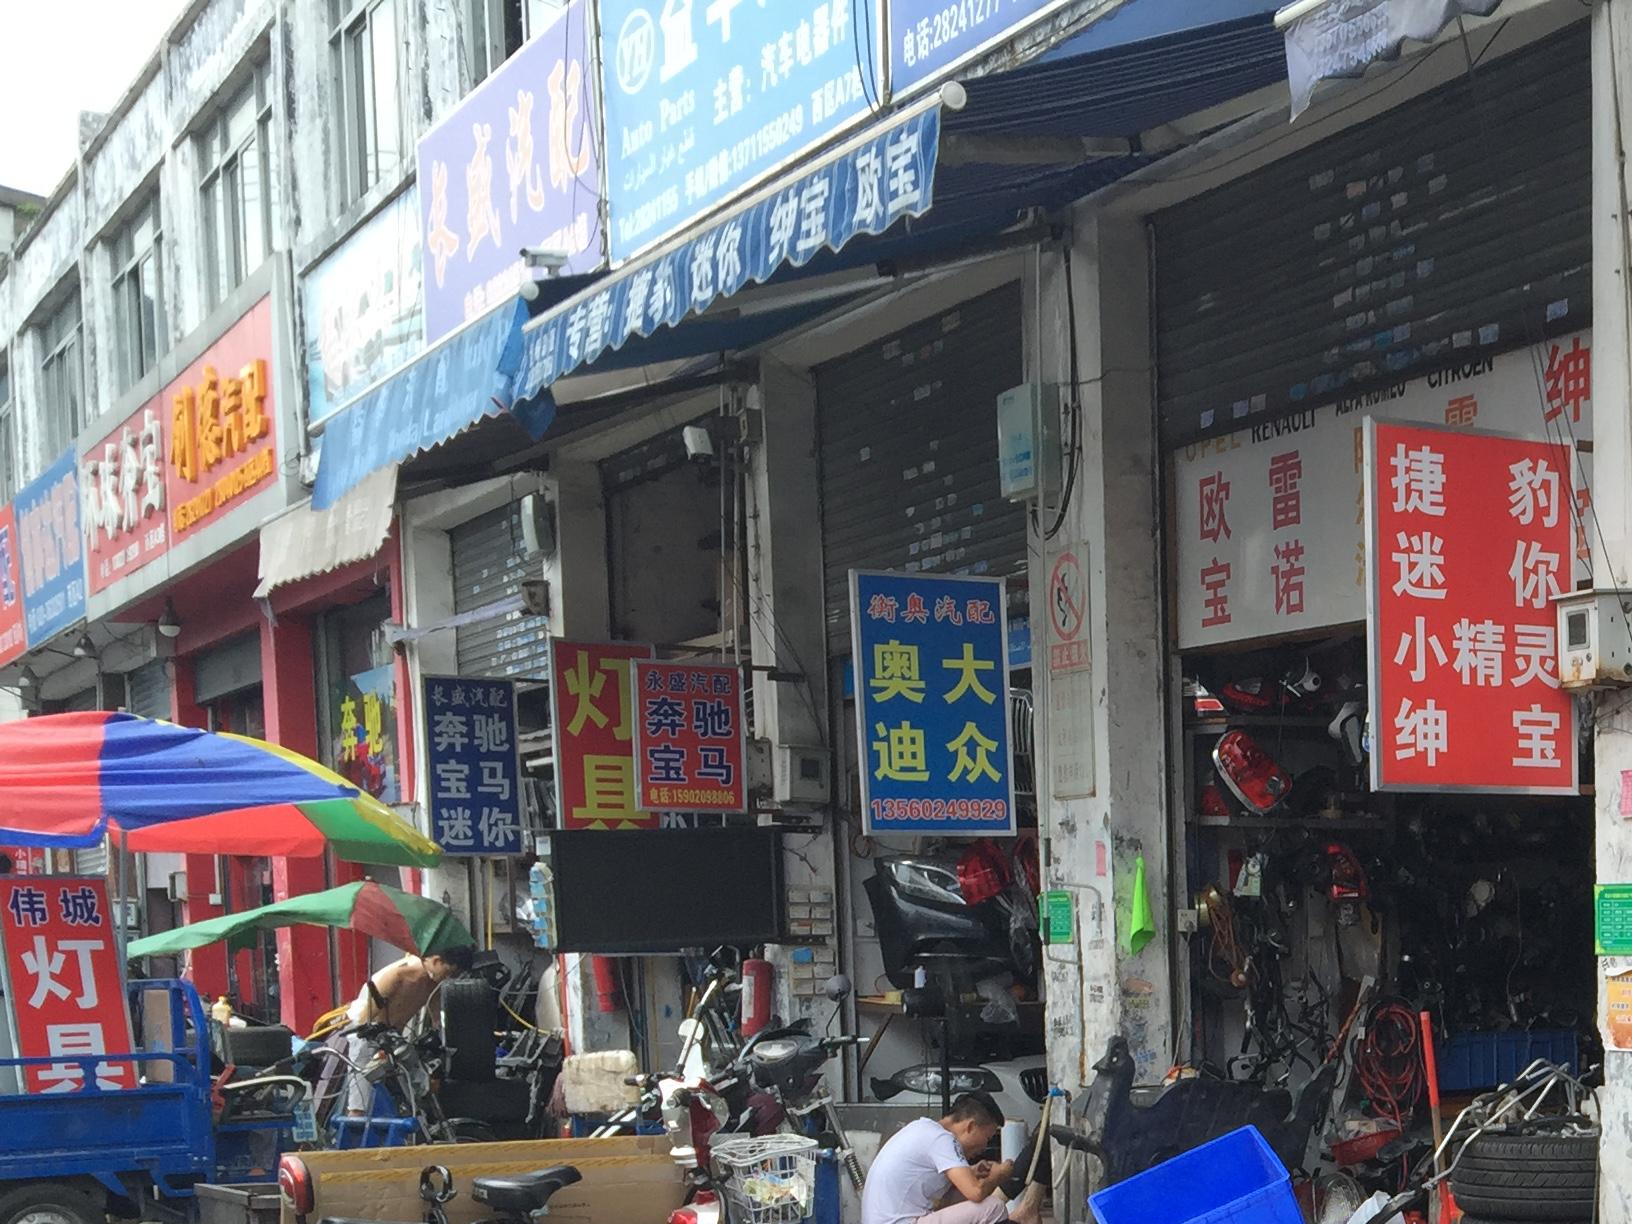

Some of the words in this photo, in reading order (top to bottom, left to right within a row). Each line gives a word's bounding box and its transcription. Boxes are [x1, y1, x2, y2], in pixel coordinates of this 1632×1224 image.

[621, 119, 653, 160] Auto
[660, 89, 695, 133] Parts
[690, 215, 742, 301] 迷你
[768, 174, 830, 263] 绅宝
[853, 132, 920, 231] 欧宝
[1390, 446, 1559, 527] 捷豹
[1198, 471, 1233, 628] 欧宝
[1267, 450, 1305, 616] 雷诺
[1392, 531, 1560, 609] 迷你
[646, 670, 732, 695] 永盛汽配
[1394, 615, 1560, 688] 小精灵
[434, 711, 510, 754] 奔驰
[646, 697, 733, 739] 奔驰
[1394, 698, 1561, 769] 绅宝
[437, 760, 510, 801] 宝马
[648, 744, 733, 786] 宝马
[439, 807, 516, 847] 迷你
[872, 799, 1007, 821] 13560249929
[8, 886, 102, 927] 伟城
[21, 935, 124, 1094] 灯具
